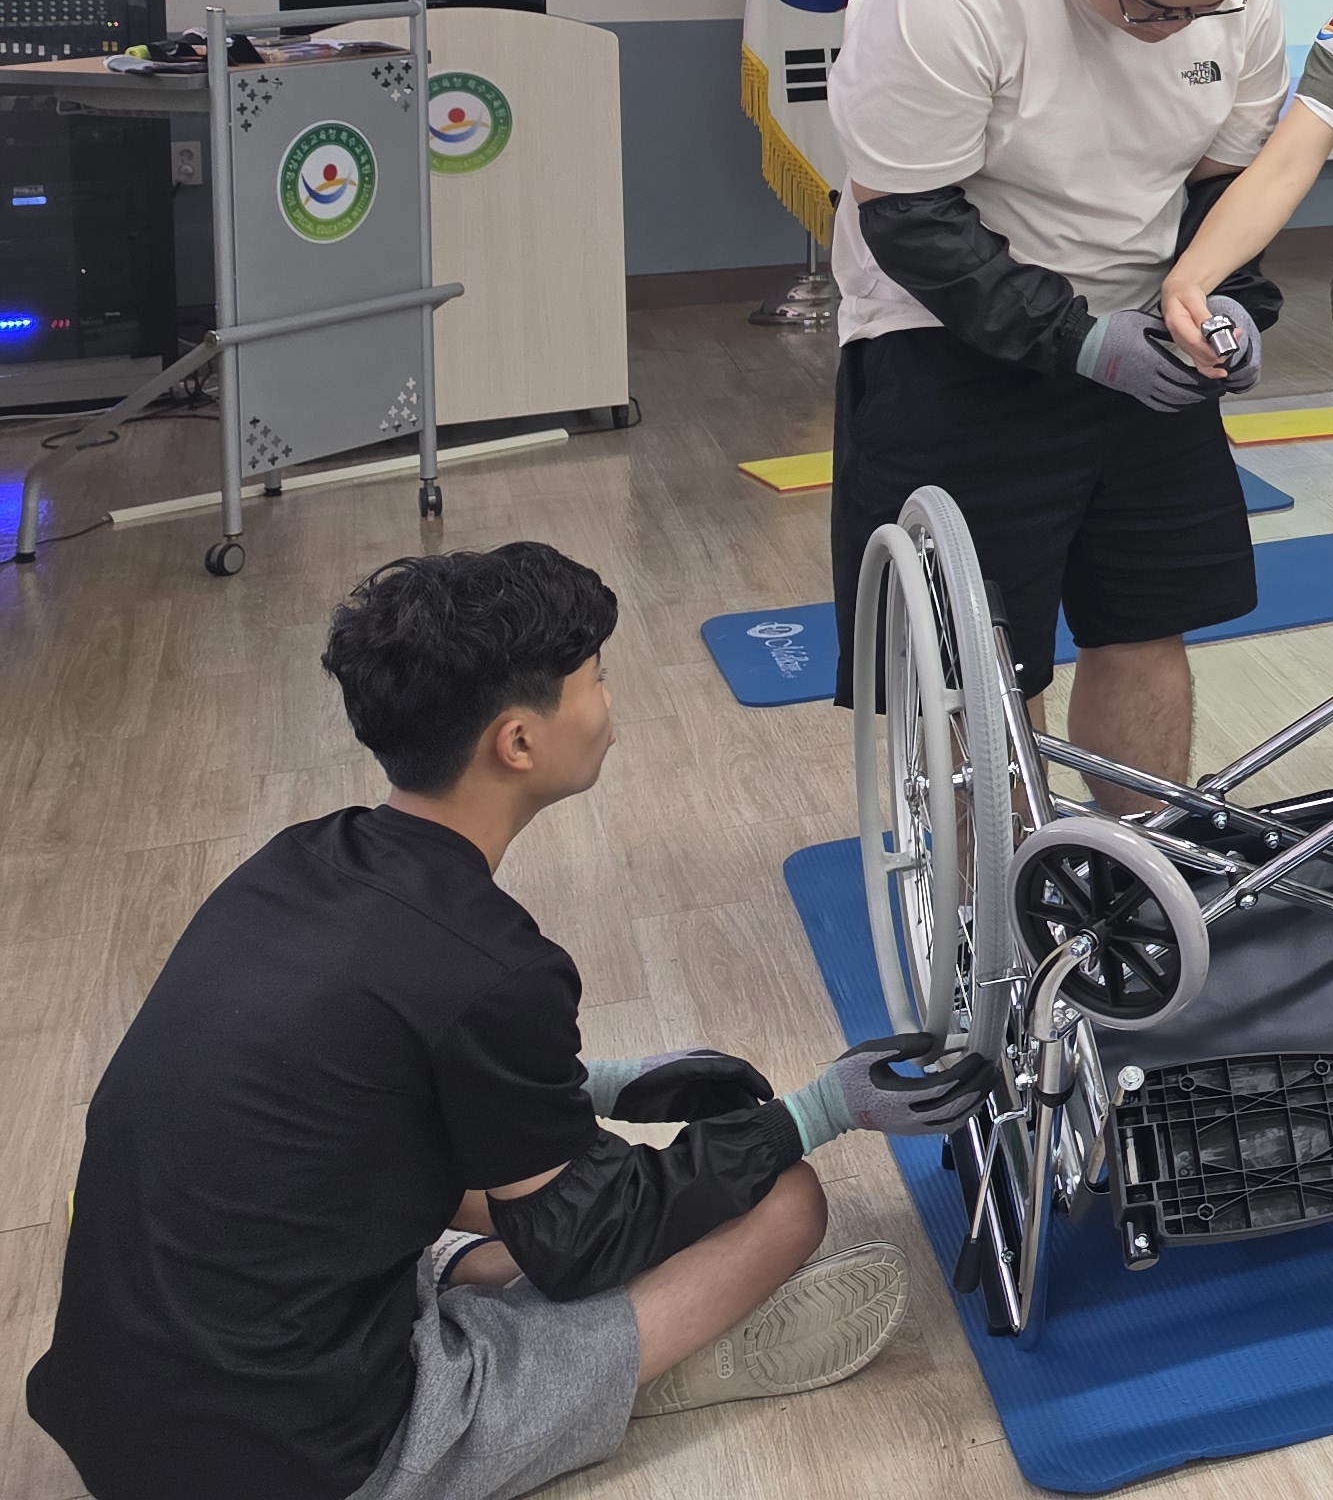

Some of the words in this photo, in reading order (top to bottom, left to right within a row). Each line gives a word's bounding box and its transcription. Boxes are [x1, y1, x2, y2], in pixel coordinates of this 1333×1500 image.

[1193, 61, 1210, 70] THE
[1181, 69, 1211, 80] NORTH
[1189, 76, 1211, 85] FACE
[719, 1341, 731, 1377] crocs
